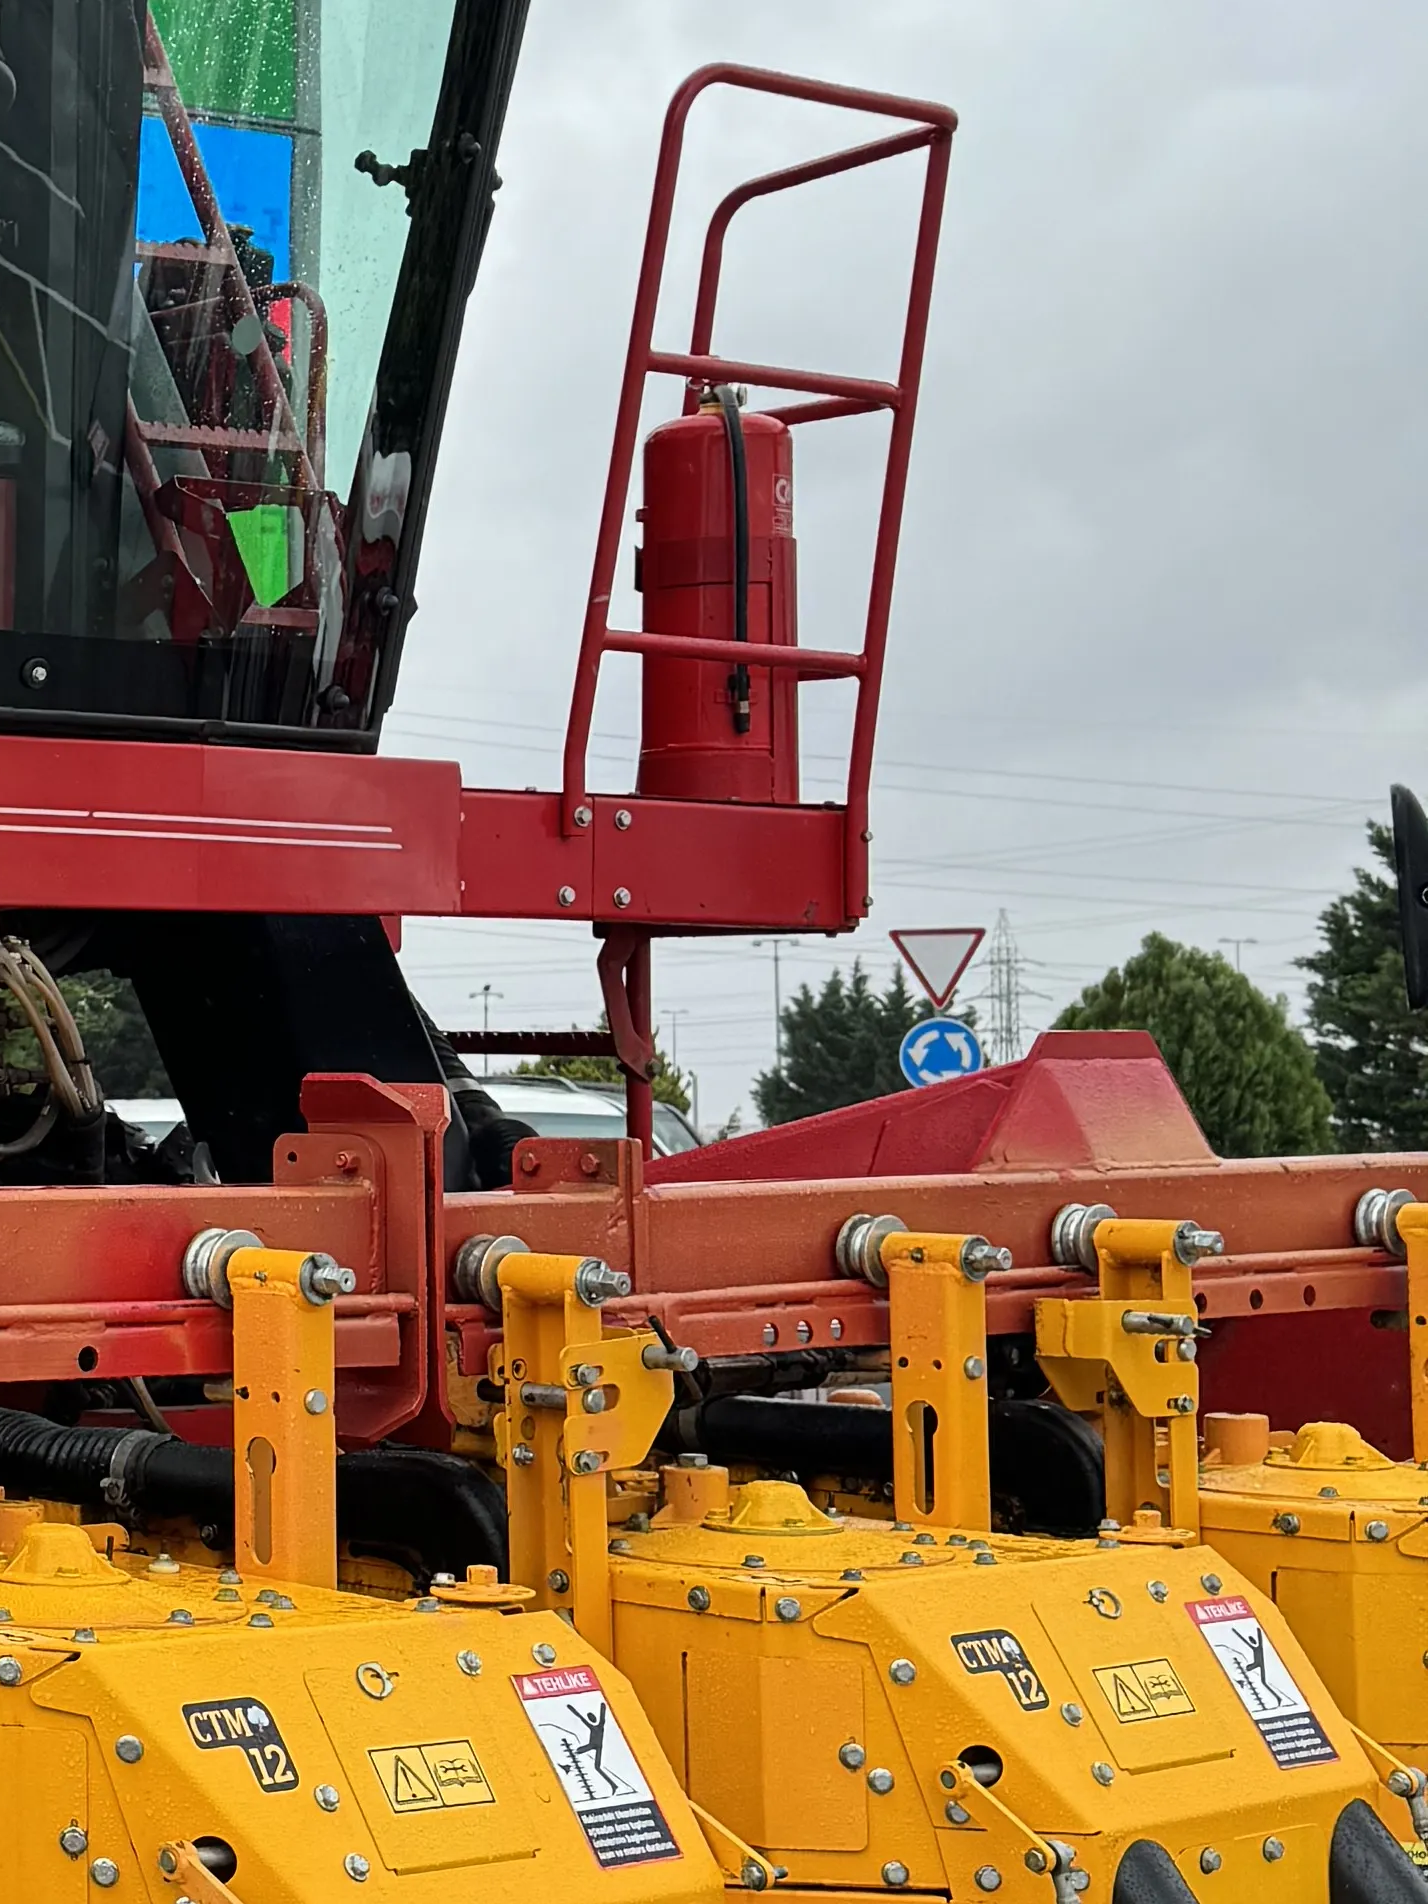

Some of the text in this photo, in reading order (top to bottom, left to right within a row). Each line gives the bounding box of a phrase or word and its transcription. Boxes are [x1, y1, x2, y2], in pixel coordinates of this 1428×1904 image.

[957, 1637, 1009, 1668] CTM
[533, 1671, 592, 1692] TEHLİKE
[1007, 1669, 1046, 1704] 12
[189, 1707, 253, 1742] CTM
[248, 1744, 295, 1785] 12
